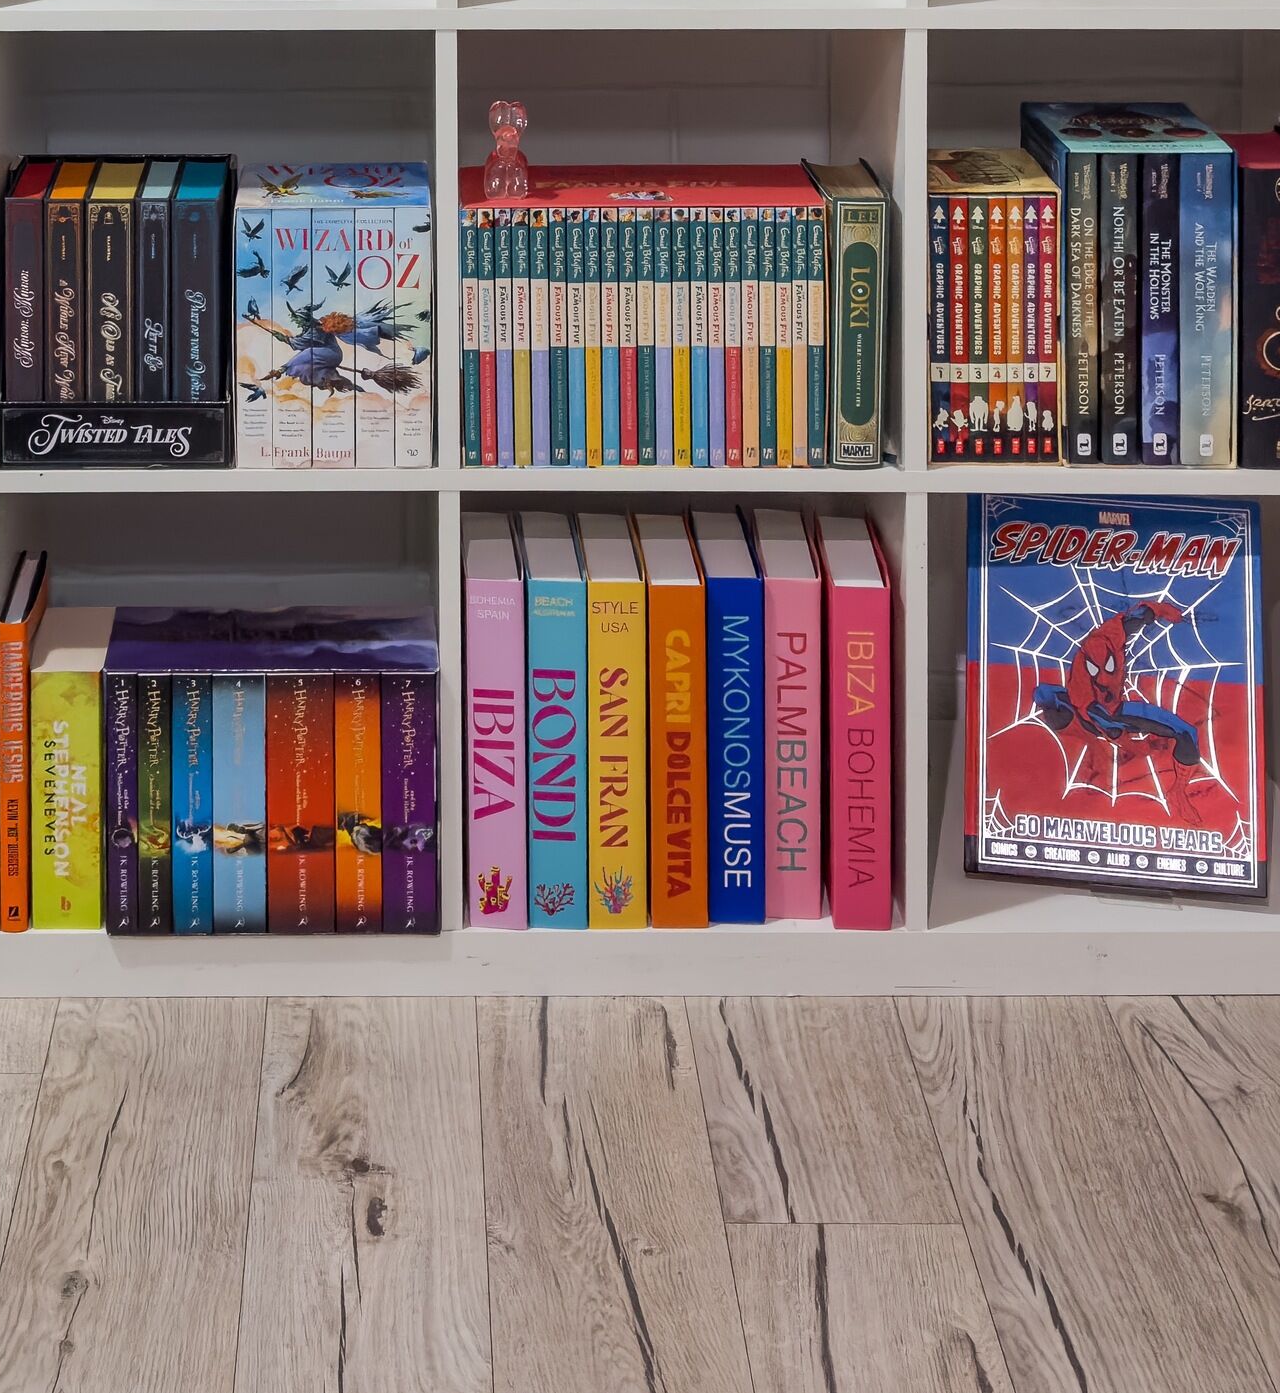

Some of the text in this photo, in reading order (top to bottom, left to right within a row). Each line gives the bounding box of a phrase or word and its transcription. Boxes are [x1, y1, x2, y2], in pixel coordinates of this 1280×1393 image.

[847, 211, 878, 222] LEE
[1083, 217, 1095, 236] ON
[275, 228, 413, 251] WIZARD of
[1084, 241, 1094, 259] THE
[357, 253, 420, 291] OZ
[466, 251, 475, 274] Blyton
[795, 248, 806, 275] Blyton
[1070, 208, 1082, 338] DARK SEA OF DARKNESS
[1083, 262, 1095, 290] EDGE
[1113, 256, 1125, 276] OR
[1149, 233, 1160, 320] IN THE HOLLOWS
[1160, 239, 1172, 313] THE MONSTER
[1194, 222, 1206, 332] AND THE WOLF KING
[1206, 242, 1217, 312] THE WARDEN
[850, 266, 871, 328] LOKI
[1084, 293, 1094, 308] OF
[1113, 280, 1125, 295] BE
[936, 262, 944, 355] GRAPHIC ADVENTURES
[1044, 262, 1052, 354] GRAPHIC ADVENTURES
[1113, 298, 1125, 337] EATEN
[1045, 370, 1051, 378] 7
[1078, 352, 1089, 415] PETERSON
[100, 415, 125, 426] Disney
[261, 446, 352, 459] L. Frank Baum
[842, 445, 872, 457] MARVEL
[1098, 511, 1131, 526] MARVEL
[988, 521, 1242, 580] SPIDER-MAN
[477, 609, 510, 620] SPAIN
[592, 601, 639, 615] STYLE
[601, 622, 629, 633] USA
[2, 641, 24, 783] DANGEROUS JESUS
[116, 689, 130, 768] HARRY POTTER
[402, 691, 416, 769] HARRY POTTER
[472, 688, 516, 820] IBIZA
[532, 668, 577, 842] BONDI
[599, 667, 629, 848] SAN FRAN
[665, 629, 692, 899] CAPRI DOLCE VITA
[847, 631, 875, 888] IBIZA BOHEMIA
[8, 799, 20, 820] KEVIN
[44, 740, 57, 857] SEVENEVES
[53, 720, 71, 876] STEPHENSON
[71, 763, 87, 827] NEAL
[991, 843, 1018, 857] COMICS
[1015, 814, 1223, 852] 60 MARVELOUS YEARS
[1044, 847, 1080, 862] CREATORS
[1107, 852, 1130, 867] ALLIES
[1157, 857, 1186, 873] ENEMIES
[1213, 862, 1245, 877] CULTURE
[406, 870, 414, 912] ROWLING
